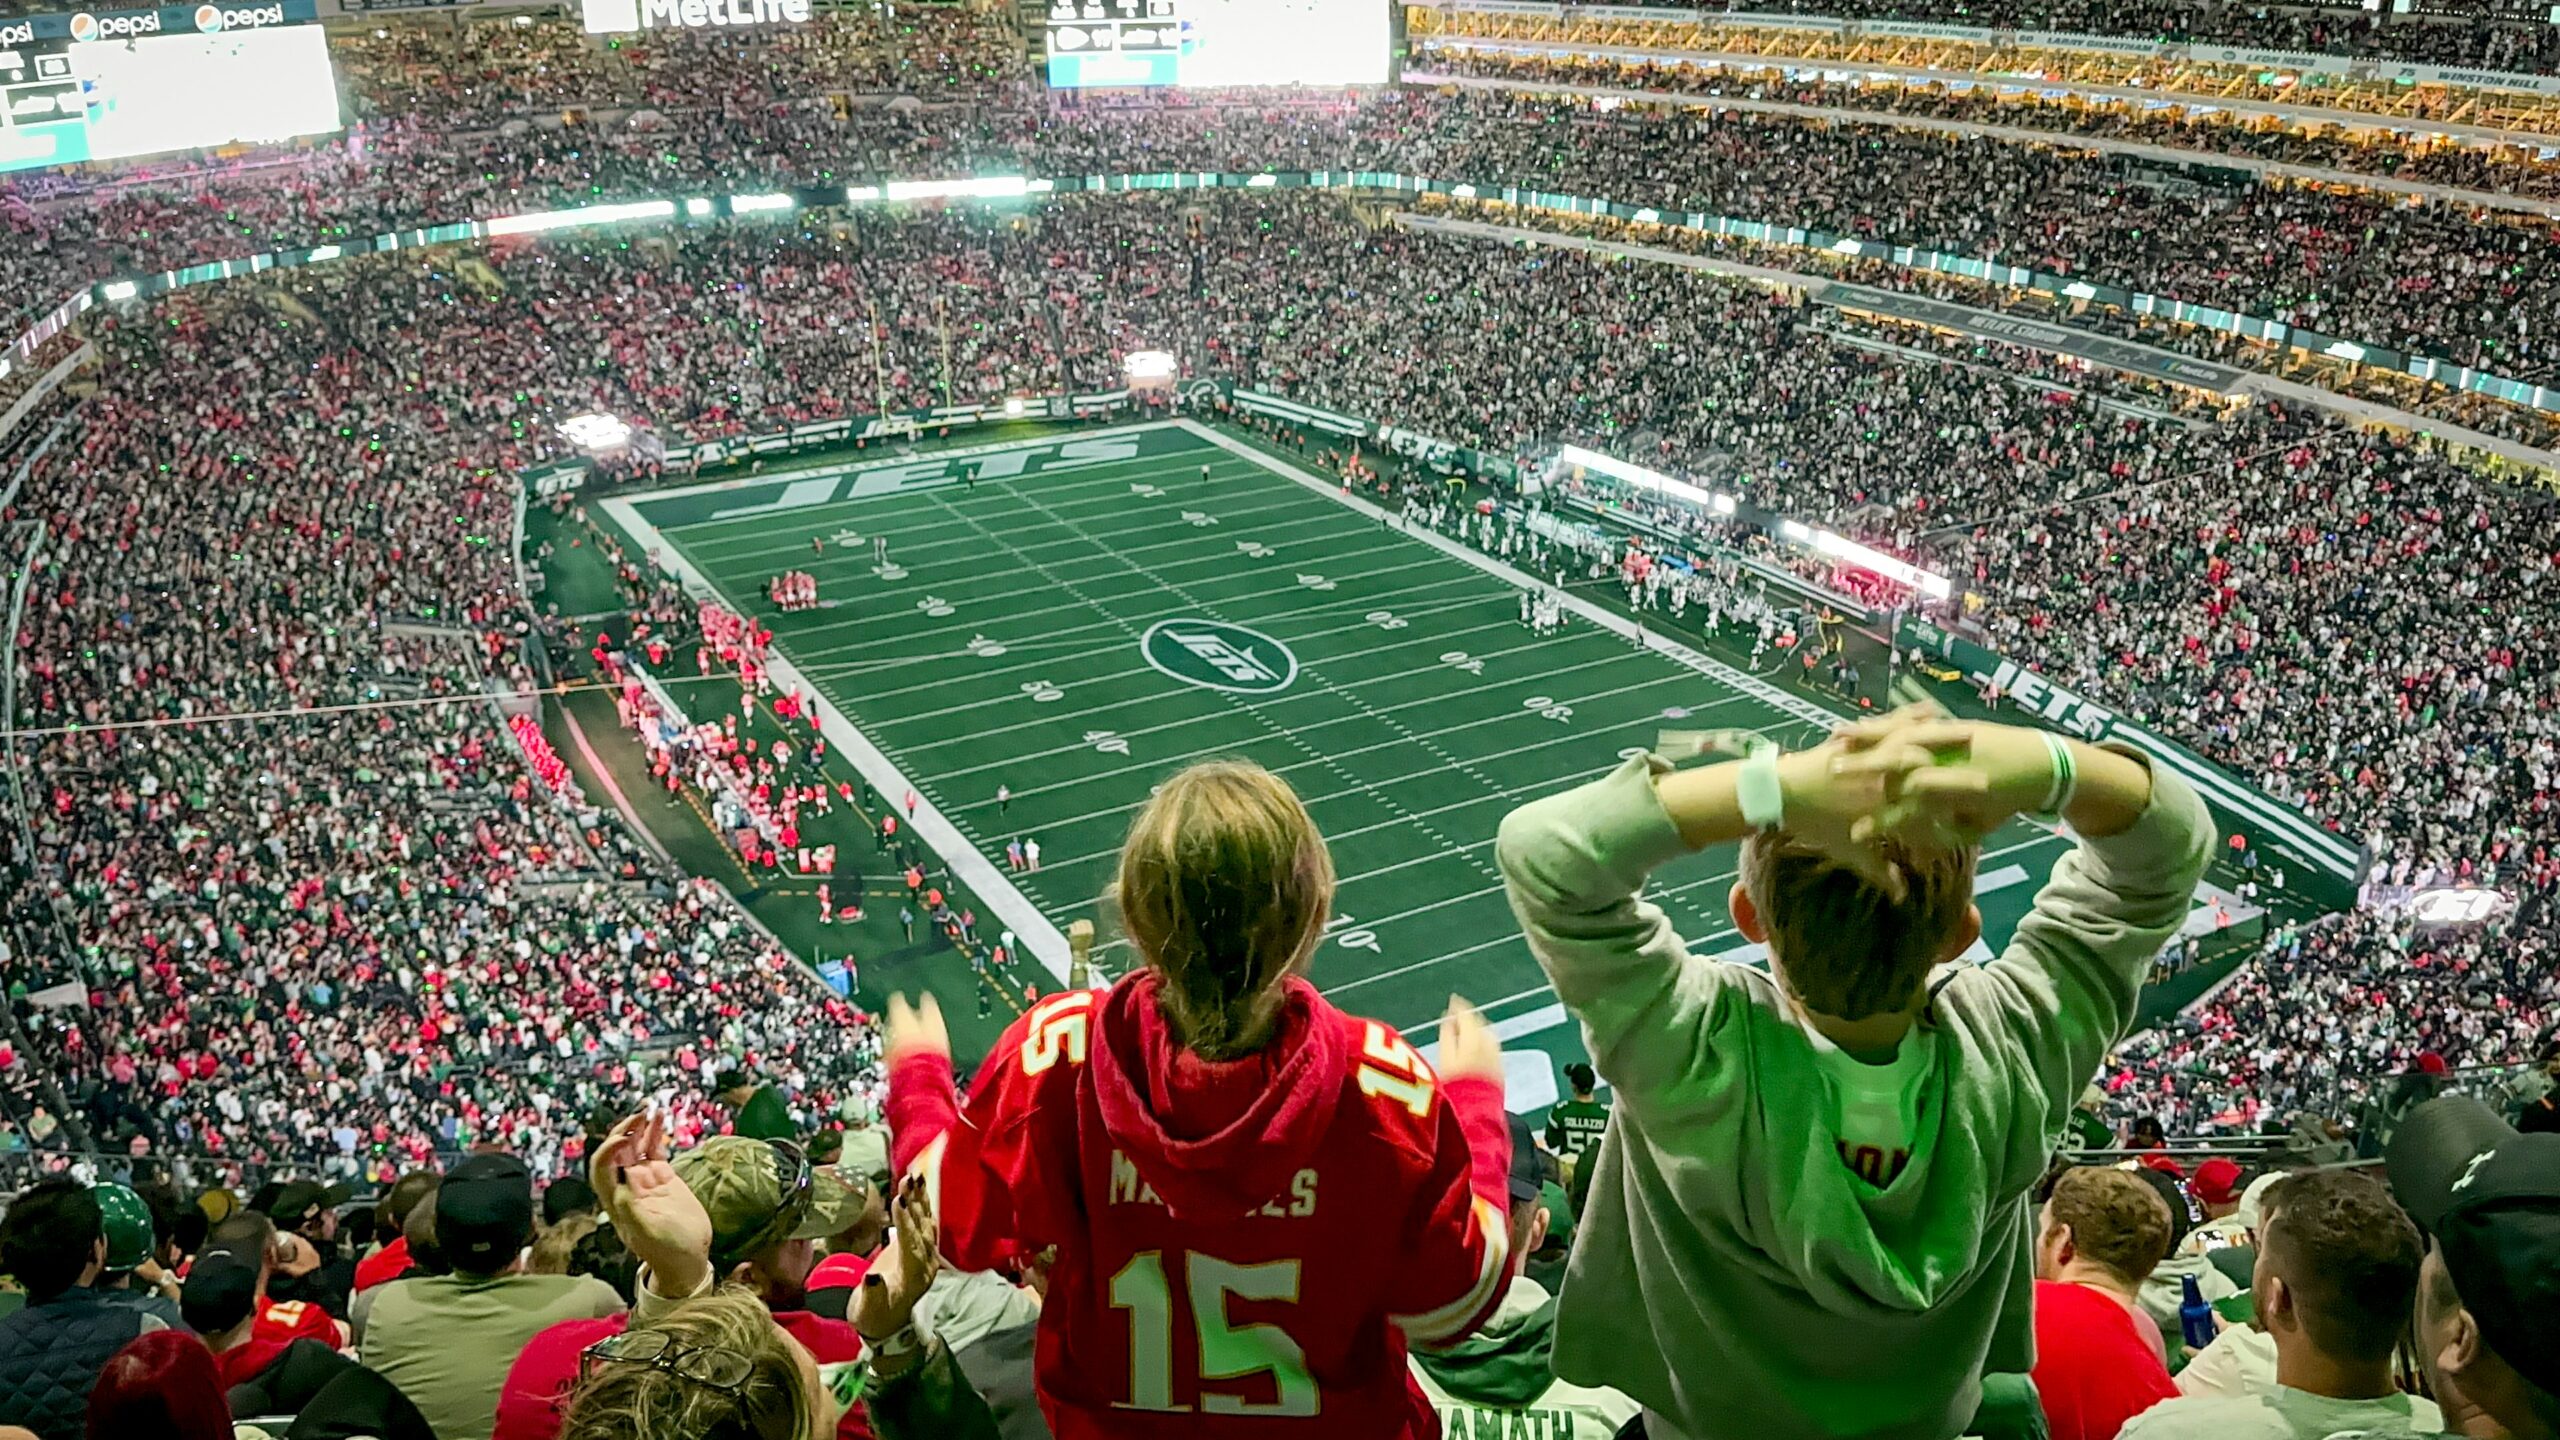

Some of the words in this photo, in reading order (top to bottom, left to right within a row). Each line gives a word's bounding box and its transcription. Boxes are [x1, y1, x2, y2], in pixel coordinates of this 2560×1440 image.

[99, 11, 161, 38] pepsi
[223, 4, 284, 30] pepsi
[641, 0, 809, 28] MetLife
[0, 21, 34, 48] psi
[2047, 37, 2084, 46] LARRY
[2086, 40, 2154, 51] GRANTHAM
[2246, 54, 2280, 64] LEON
[2282, 57, 2316, 67] HESS
[2398, 67, 2416, 77] 75
[2438, 71, 2505, 86] WINSTON
[2507, 78, 2540, 90] HILL
[711, 434, 1141, 520] JETS
[1163, 628, 1281, 681] JETS
[1020, 681, 1064, 702] 50
[1663, 645, 1781, 697] INTERCEPT
[1782, 698, 1838, 729] CAN
[1972, 660, 2114, 740] JETS
[1322, 912, 1377, 949] 10
[1020, 991, 1093, 1077] 15
[1356, 1020, 1436, 1118] 15
[1108, 1248, 1321, 1417] 15
[1434, 1408, 1574, 1440] AMATH
